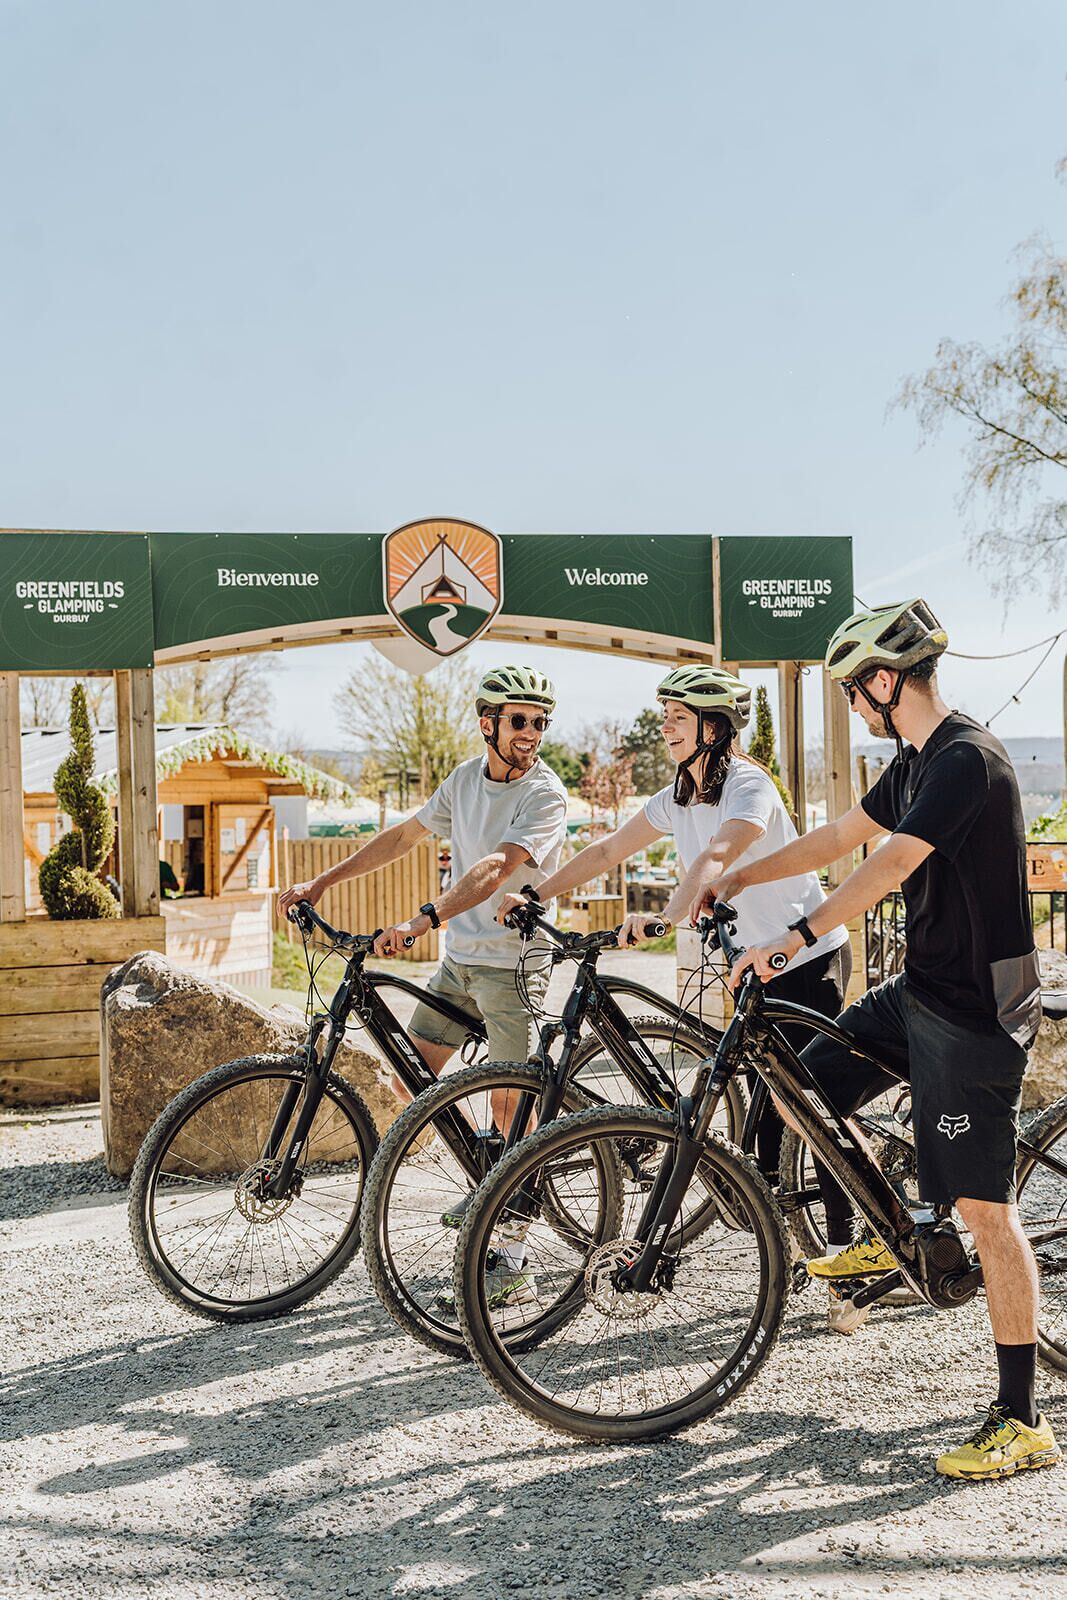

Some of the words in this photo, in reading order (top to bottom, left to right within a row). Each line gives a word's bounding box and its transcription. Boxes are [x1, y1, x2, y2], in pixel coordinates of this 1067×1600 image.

[217, 568, 319, 586] Bienvenue
[564, 568, 648, 586] Welcome
[16, 581, 125, 598] GREENFIELDS
[742, 579, 832, 595] GREENFIELDS
[38, 599, 104, 613] GLAMPING
[760, 596, 815, 608] GLAMPING
[53, 614, 90, 623] DURBUY
[391, 1032, 432, 1079] BH
[628, 1040, 674, 1092] BH
[801, 1089, 855, 1148] BH
[716, 1325, 766, 1397] MAXXIS
